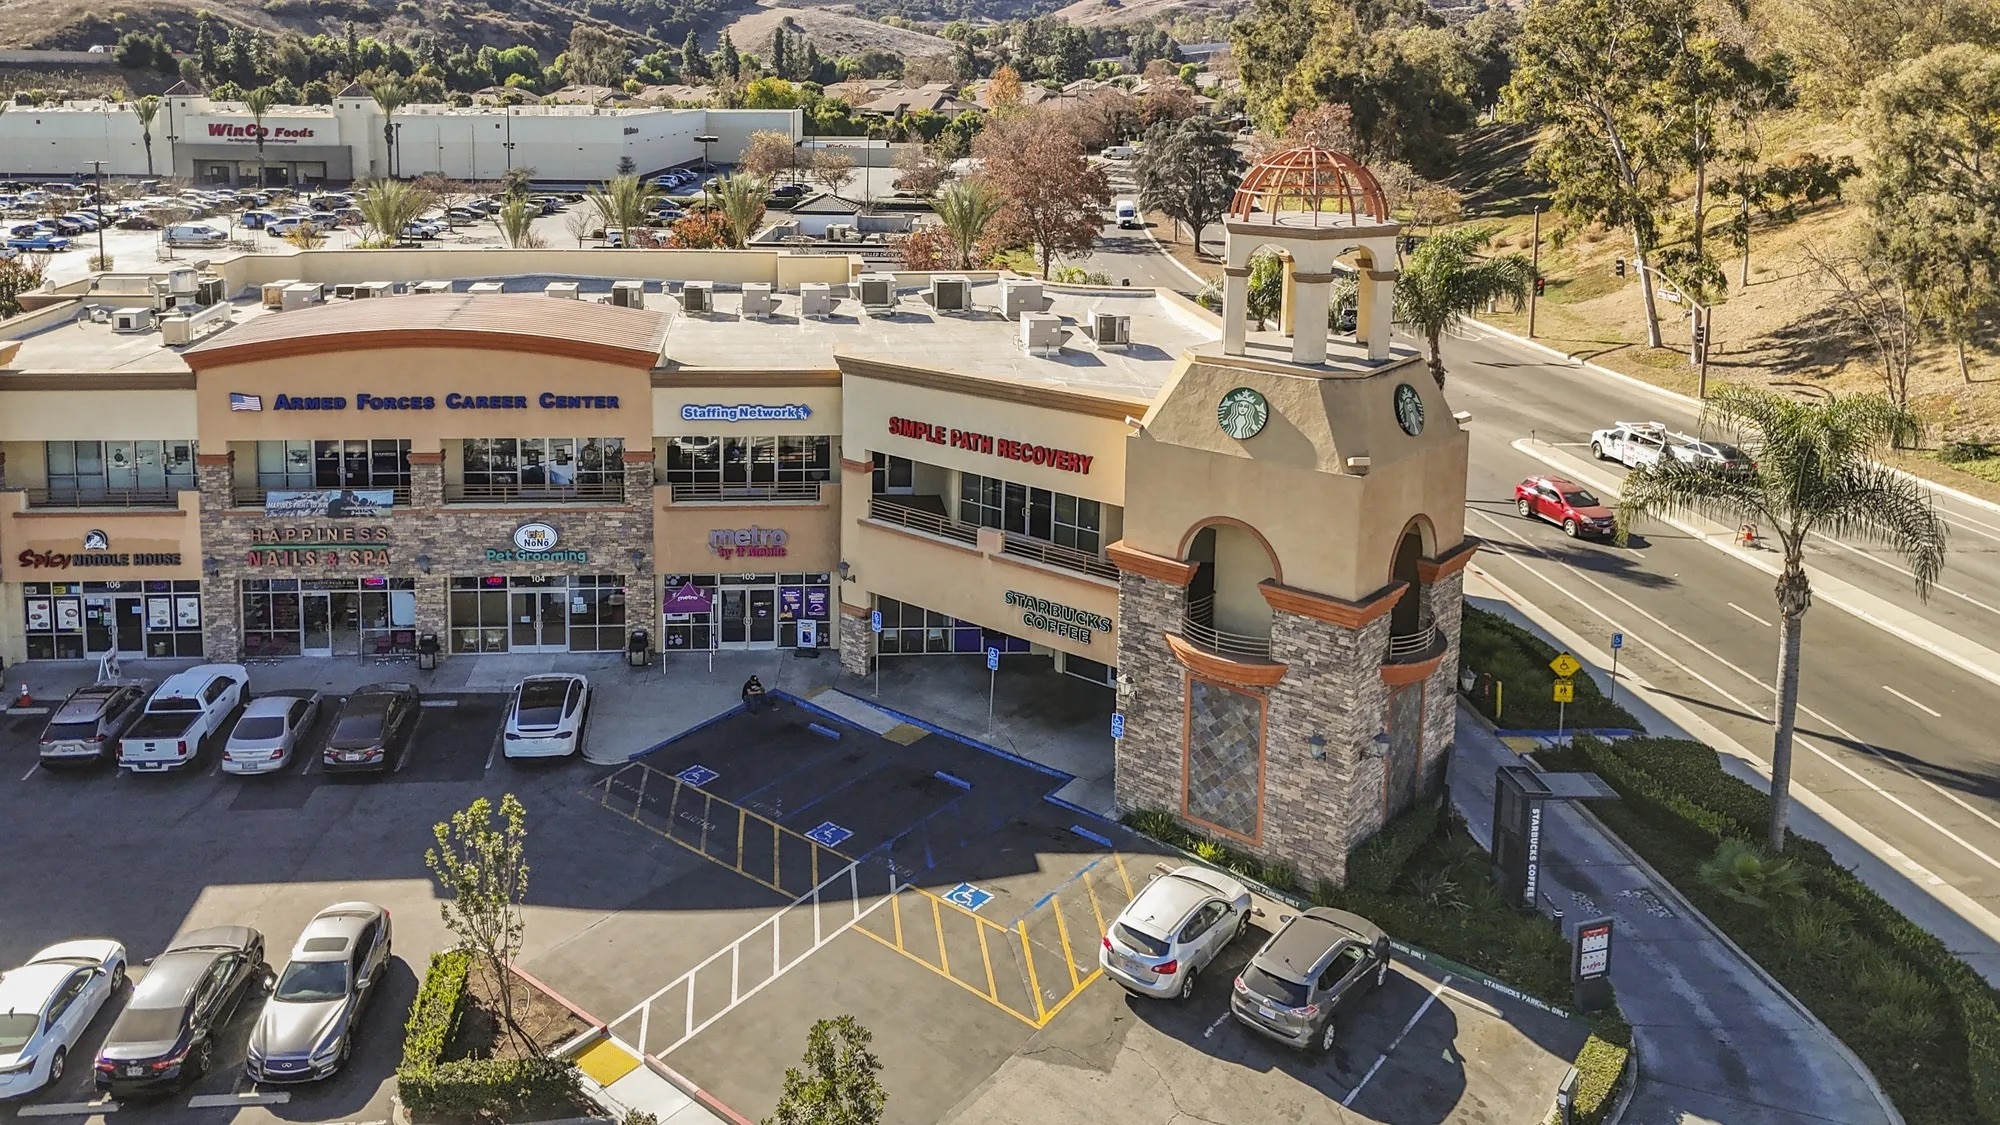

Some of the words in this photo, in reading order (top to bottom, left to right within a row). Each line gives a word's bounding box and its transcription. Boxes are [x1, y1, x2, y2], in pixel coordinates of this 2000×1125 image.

[208, 123, 269, 137] WinCo
[274, 128, 314, 138] Foods
[273, 394, 347, 410] ARMED
[357, 394, 435, 410] FORCES
[446, 393, 528, 409] CAREER
[539, 392, 620, 409] CENTER
[683, 405, 738, 421] Staffing
[739, 405, 797, 419] Network
[888, 416, 947, 445] SIMPLE
[950, 429, 993, 455] PATH
[997, 438, 1094, 475] RECOVERY
[250, 527, 388, 542] HAPPINESS
[708, 525, 788, 548] metro
[18, 549, 72, 569] Spicy
[72, 553, 130, 567] NOODLE
[133, 553, 182, 567] HOUSE
[248, 550, 317, 567] NAILS
[327, 550, 339, 567] &
[350, 550, 391, 566] SPA
[485, 549, 513, 562] Pet
[515, 549, 587, 563] Grooming
[531, 575, 546, 583] 104
[742, 572, 756, 580] 103
[105, 581, 121, 589] 106
[677, 594, 698, 602] metro
[1004, 590, 1113, 634] STARBUCKS
[1023, 611, 1092, 645] COFFEE
[1528, 808, 1540, 862] STARBUCKS
[1526, 864, 1537, 898] COFFEE
[1261, 887, 1285, 902] PARKING
[1285, 897, 1300, 908] ONLY
[1410, 949, 1427, 961] ONLY
[1483, 979, 1520, 999] STARBUCKS
[1551, 1006, 1570, 1019] ONLY
